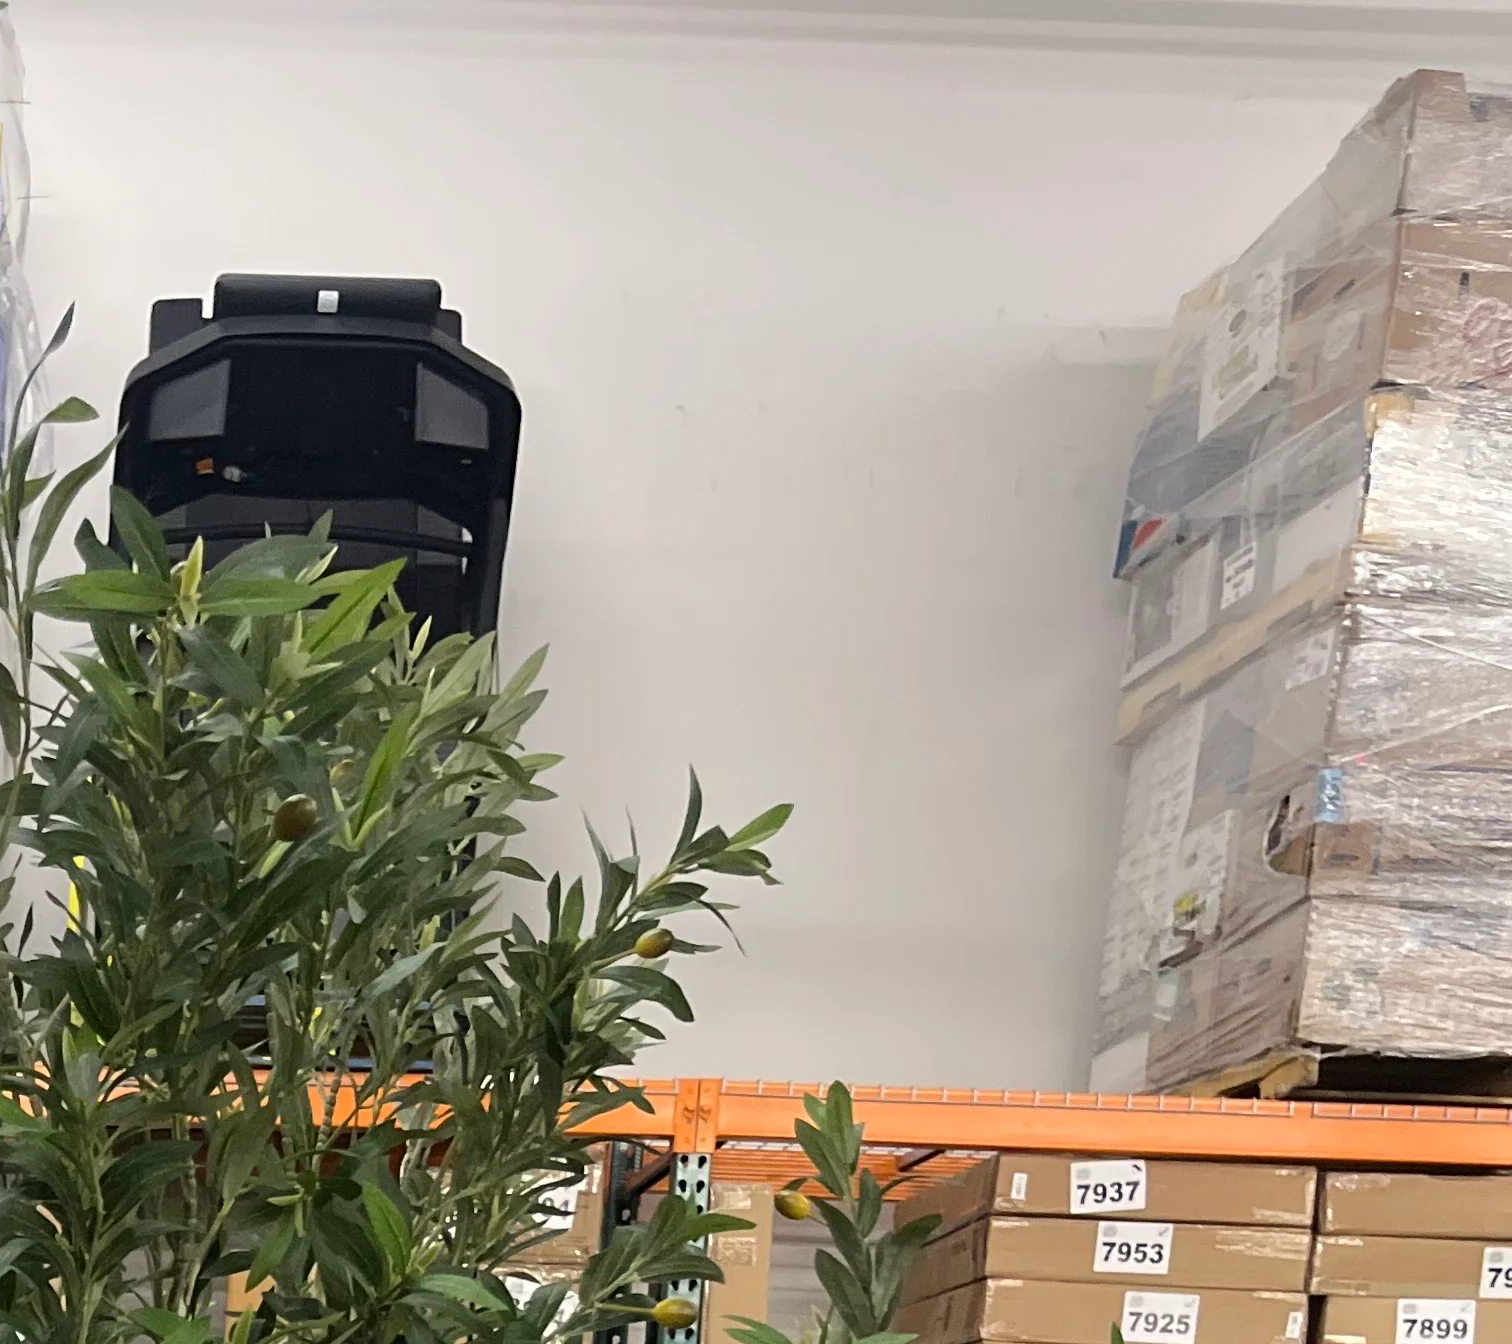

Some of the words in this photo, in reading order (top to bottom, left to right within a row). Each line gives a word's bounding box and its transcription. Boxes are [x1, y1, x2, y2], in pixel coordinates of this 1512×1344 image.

[1077, 1181, 1141, 1205] 7937
[1102, 1242, 1164, 1264] 7953
[1129, 1311, 1191, 1335] 7925
[1403, 1318, 1469, 1339] 7899
